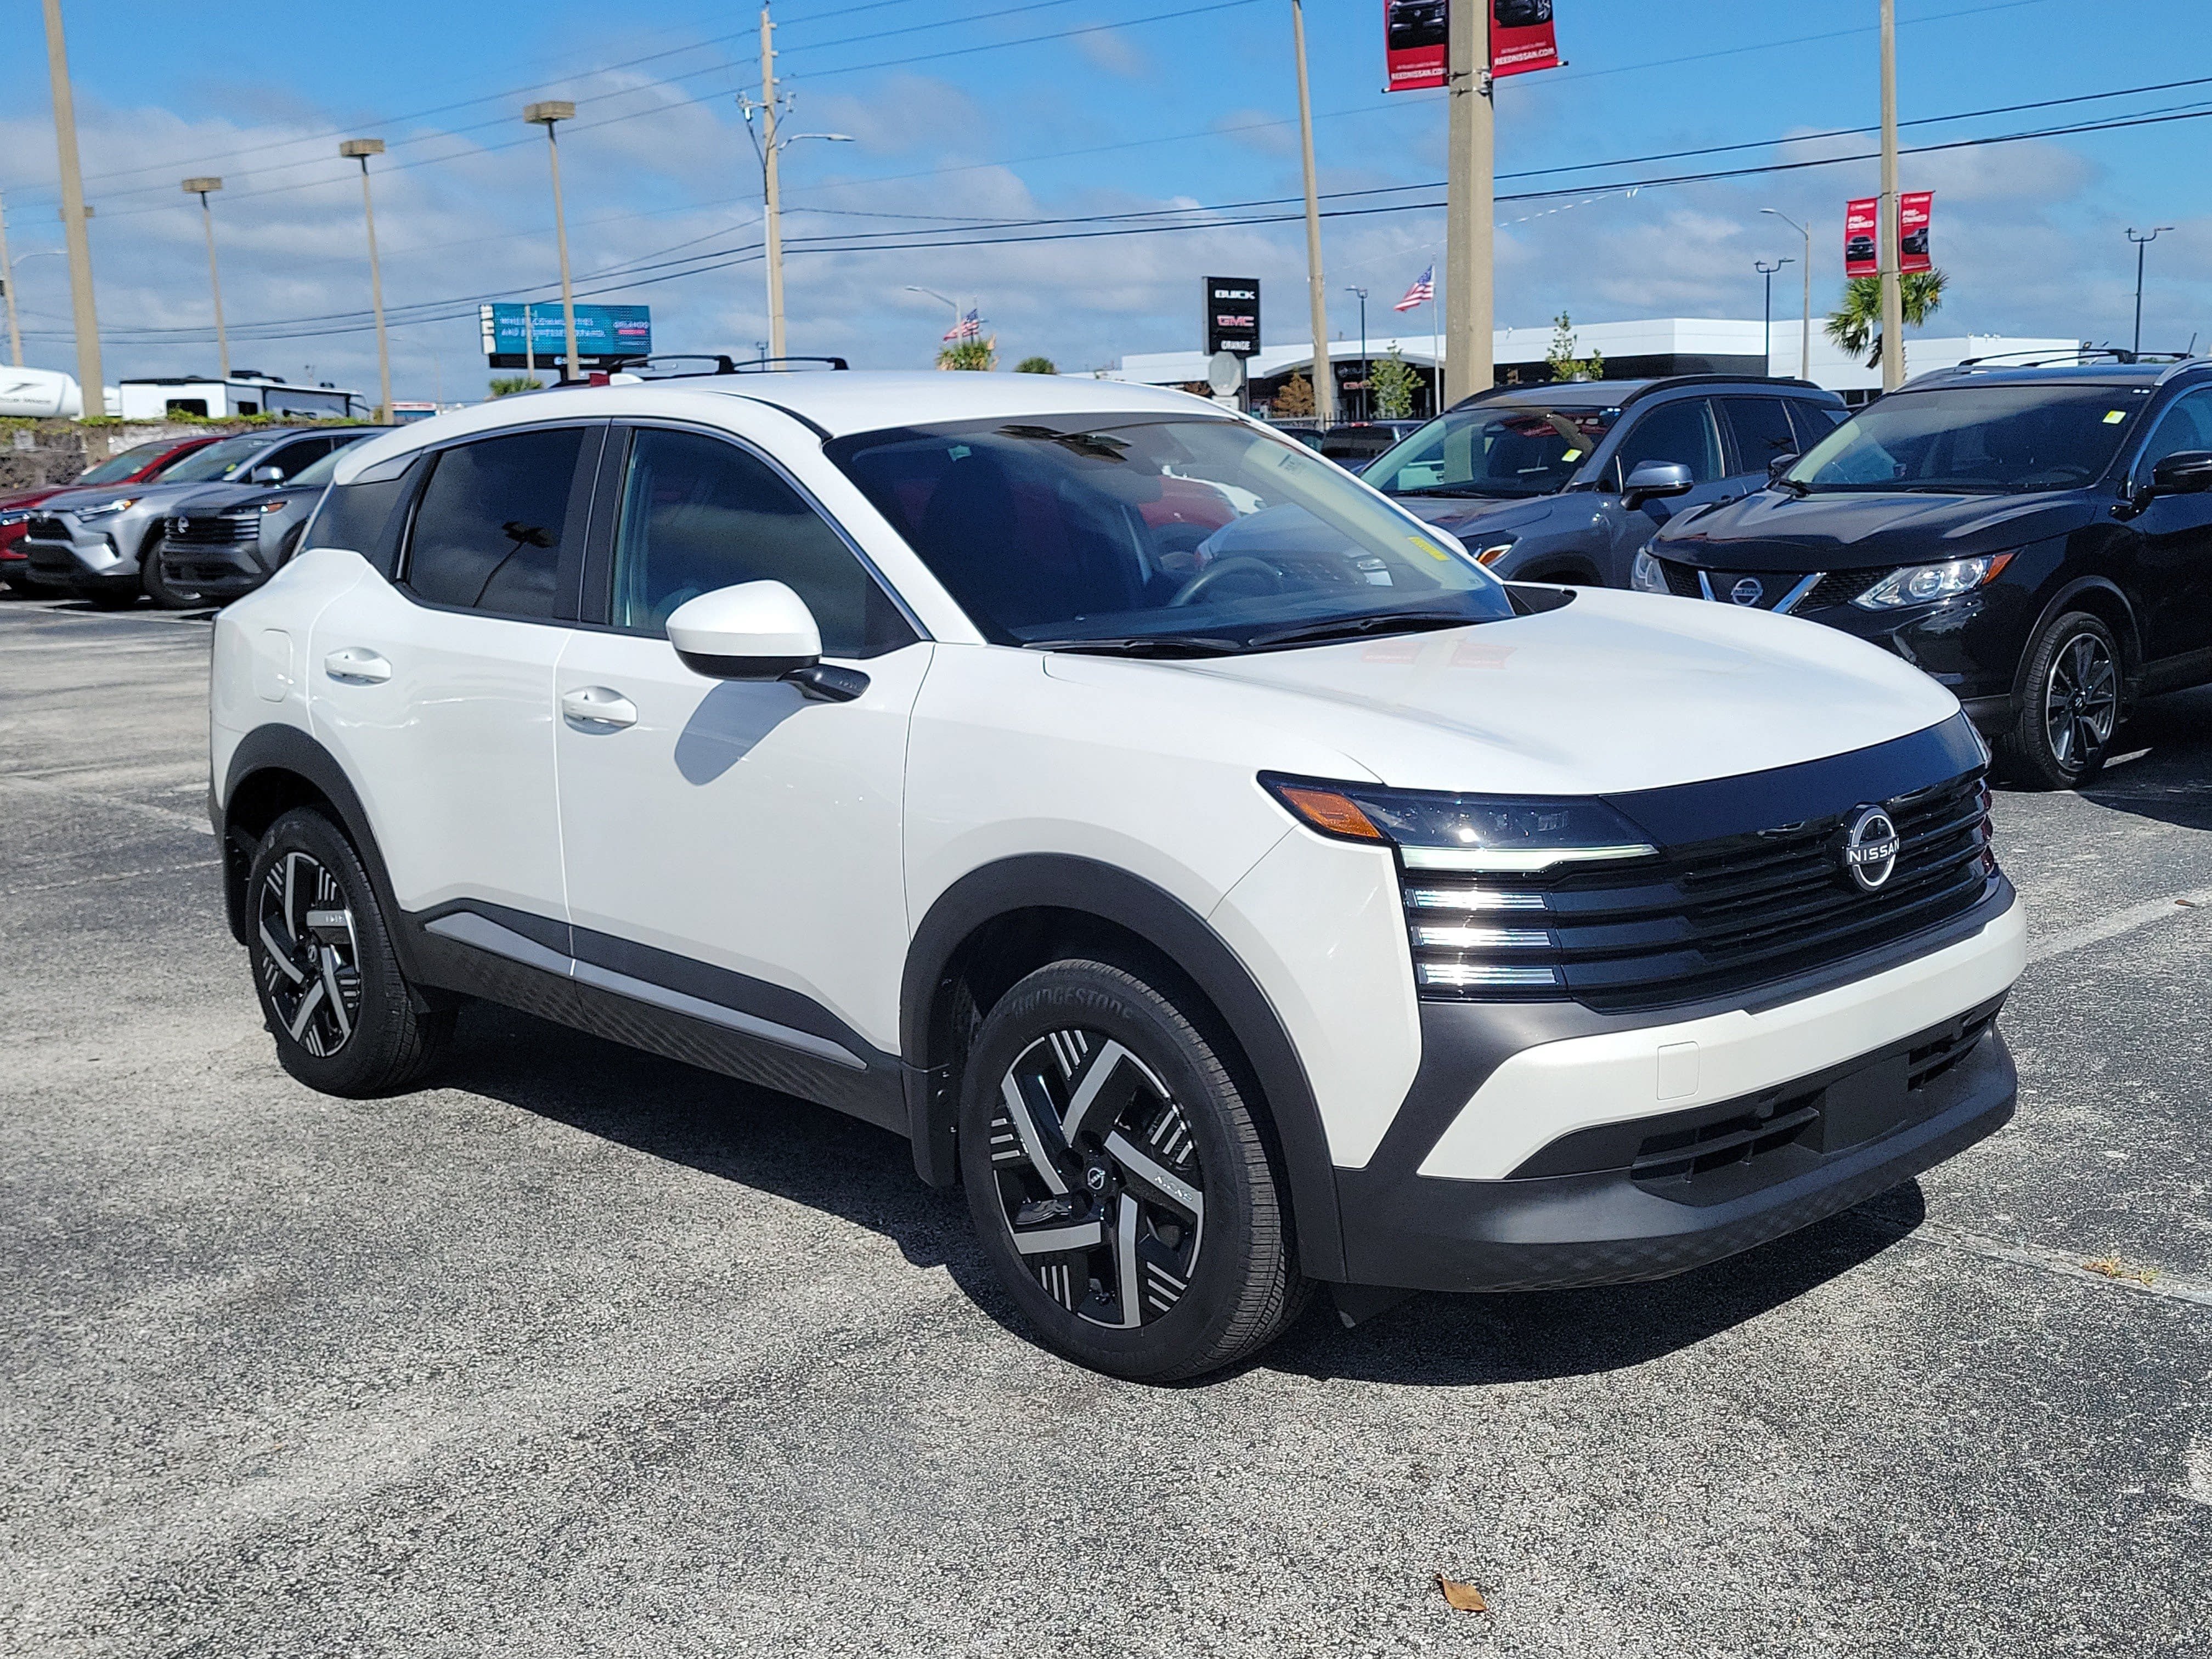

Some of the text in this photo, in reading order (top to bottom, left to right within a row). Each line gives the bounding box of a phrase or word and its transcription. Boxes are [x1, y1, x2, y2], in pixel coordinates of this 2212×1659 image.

[1215, 290, 1256, 300] BUICK
[1217, 315, 1255, 327] GMC
[1849, 837, 1900, 863] NISSAN
